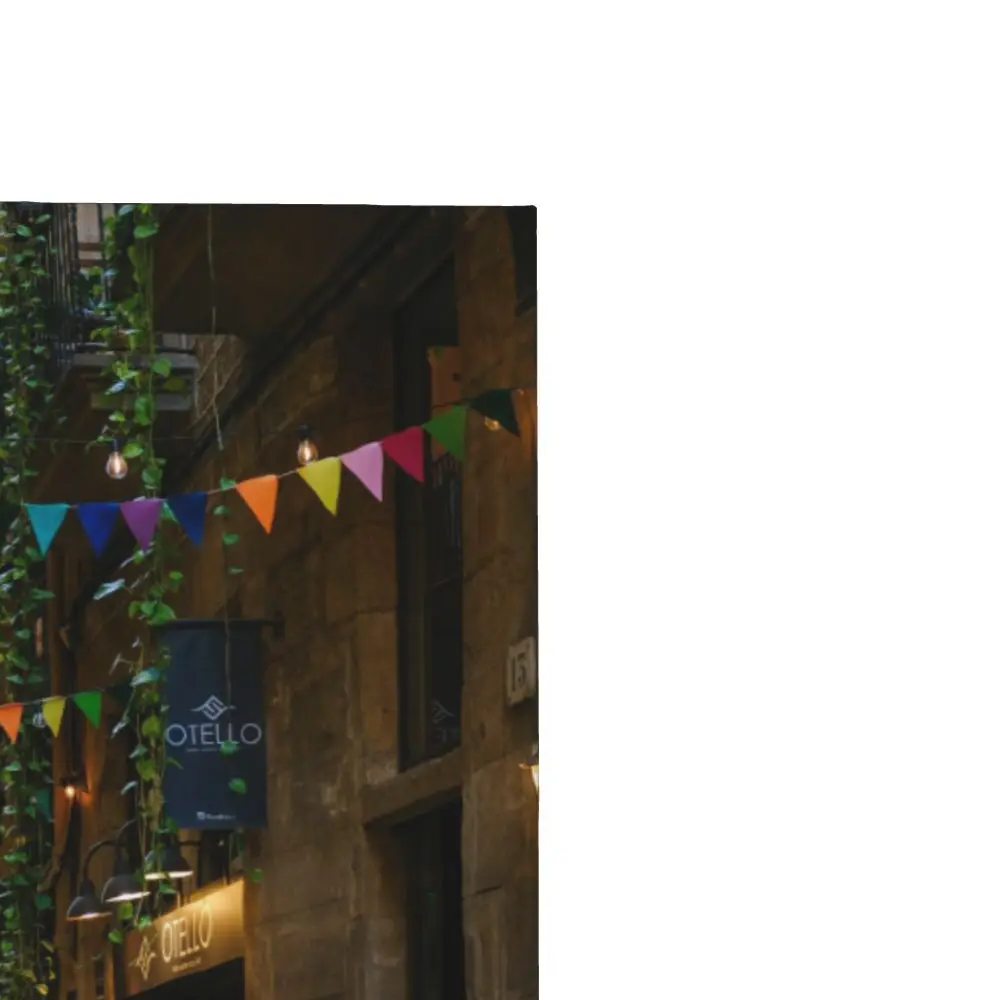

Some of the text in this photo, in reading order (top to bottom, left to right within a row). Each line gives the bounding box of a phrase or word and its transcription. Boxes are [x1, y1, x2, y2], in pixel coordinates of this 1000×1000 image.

[512, 651, 526, 692] 15
[166, 723, 262, 746] OTELLO
[161, 902, 212, 963] OTELLO
